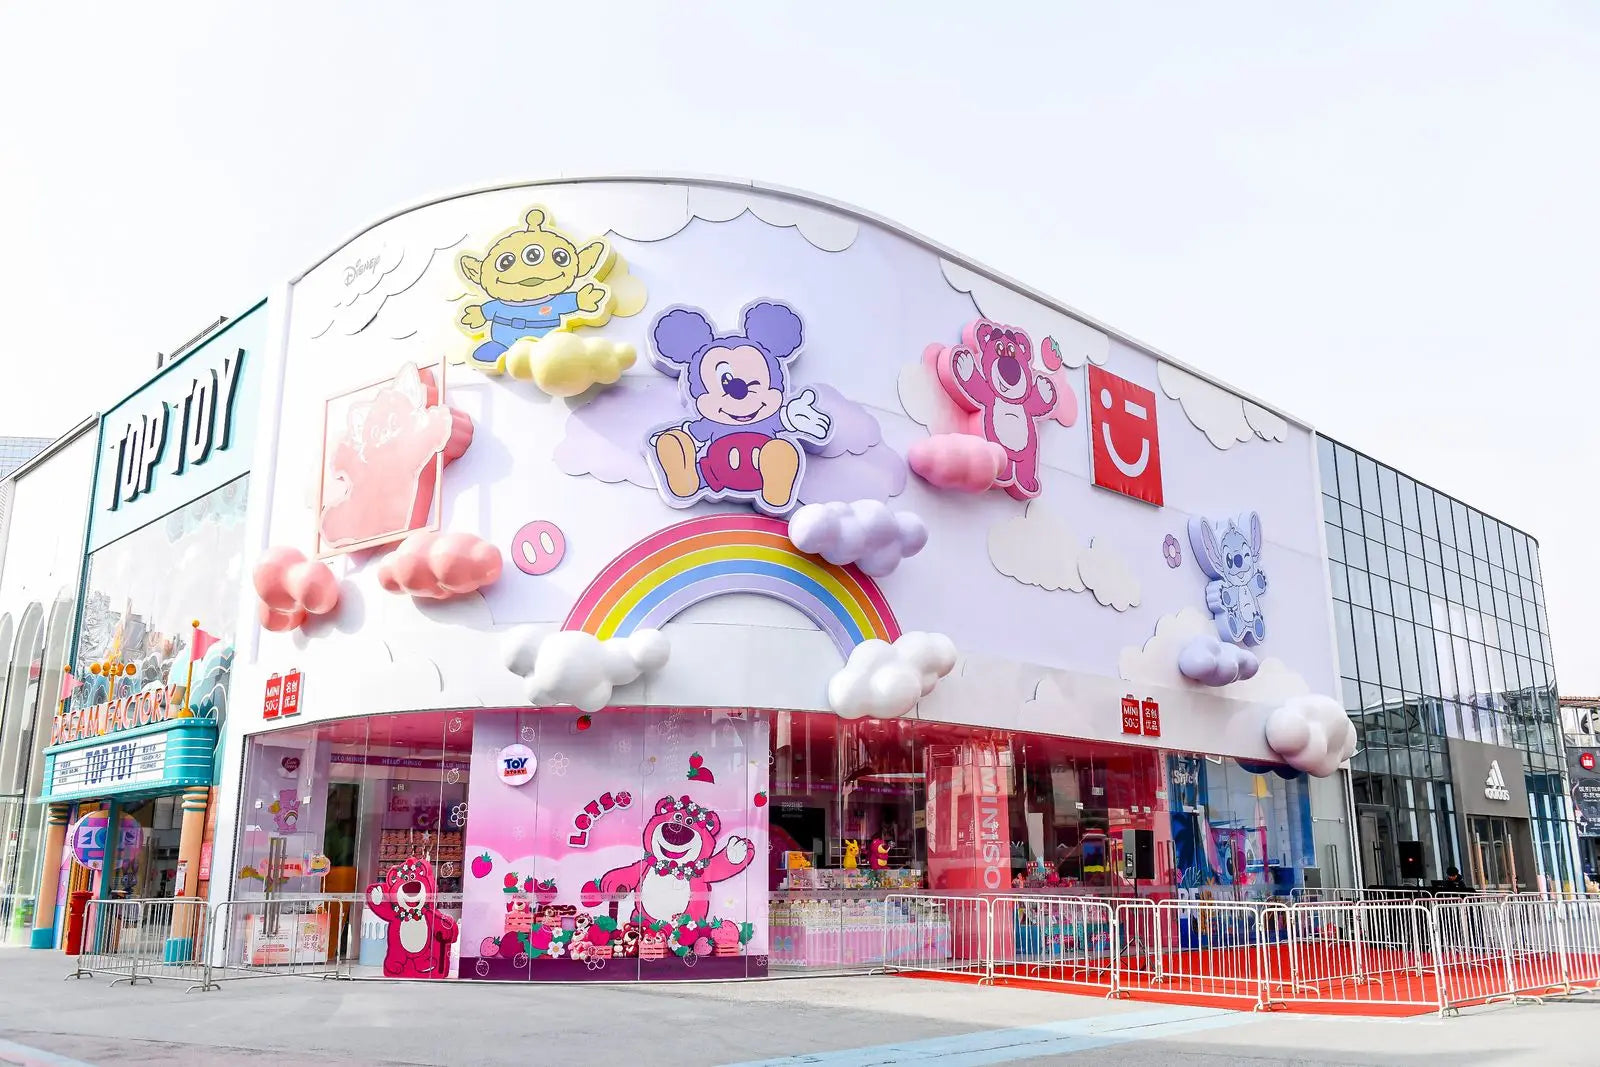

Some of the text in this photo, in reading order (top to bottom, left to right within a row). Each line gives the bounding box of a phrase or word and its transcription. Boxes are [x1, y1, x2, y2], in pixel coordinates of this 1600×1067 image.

[106, 348, 246, 512] TOP TOY
[266, 685, 280, 697] MINI
[285, 679, 297, 693] 名创
[284, 694, 296, 708] 优品
[50, 683, 177, 746] DREAM FACTORY
[1123, 705, 1139, 716] MINI
[1145, 708, 1157, 719] 名创
[1145, 719, 1158, 731] 优品
[84, 742, 137, 785] TOP TOY
[504, 757, 529, 770] TOY
[504, 768, 527, 776] STORY
[1485, 785, 1510, 801] adidas
[569, 791, 632, 846] LOTSO
[980, 766, 1001, 889] MINISO
